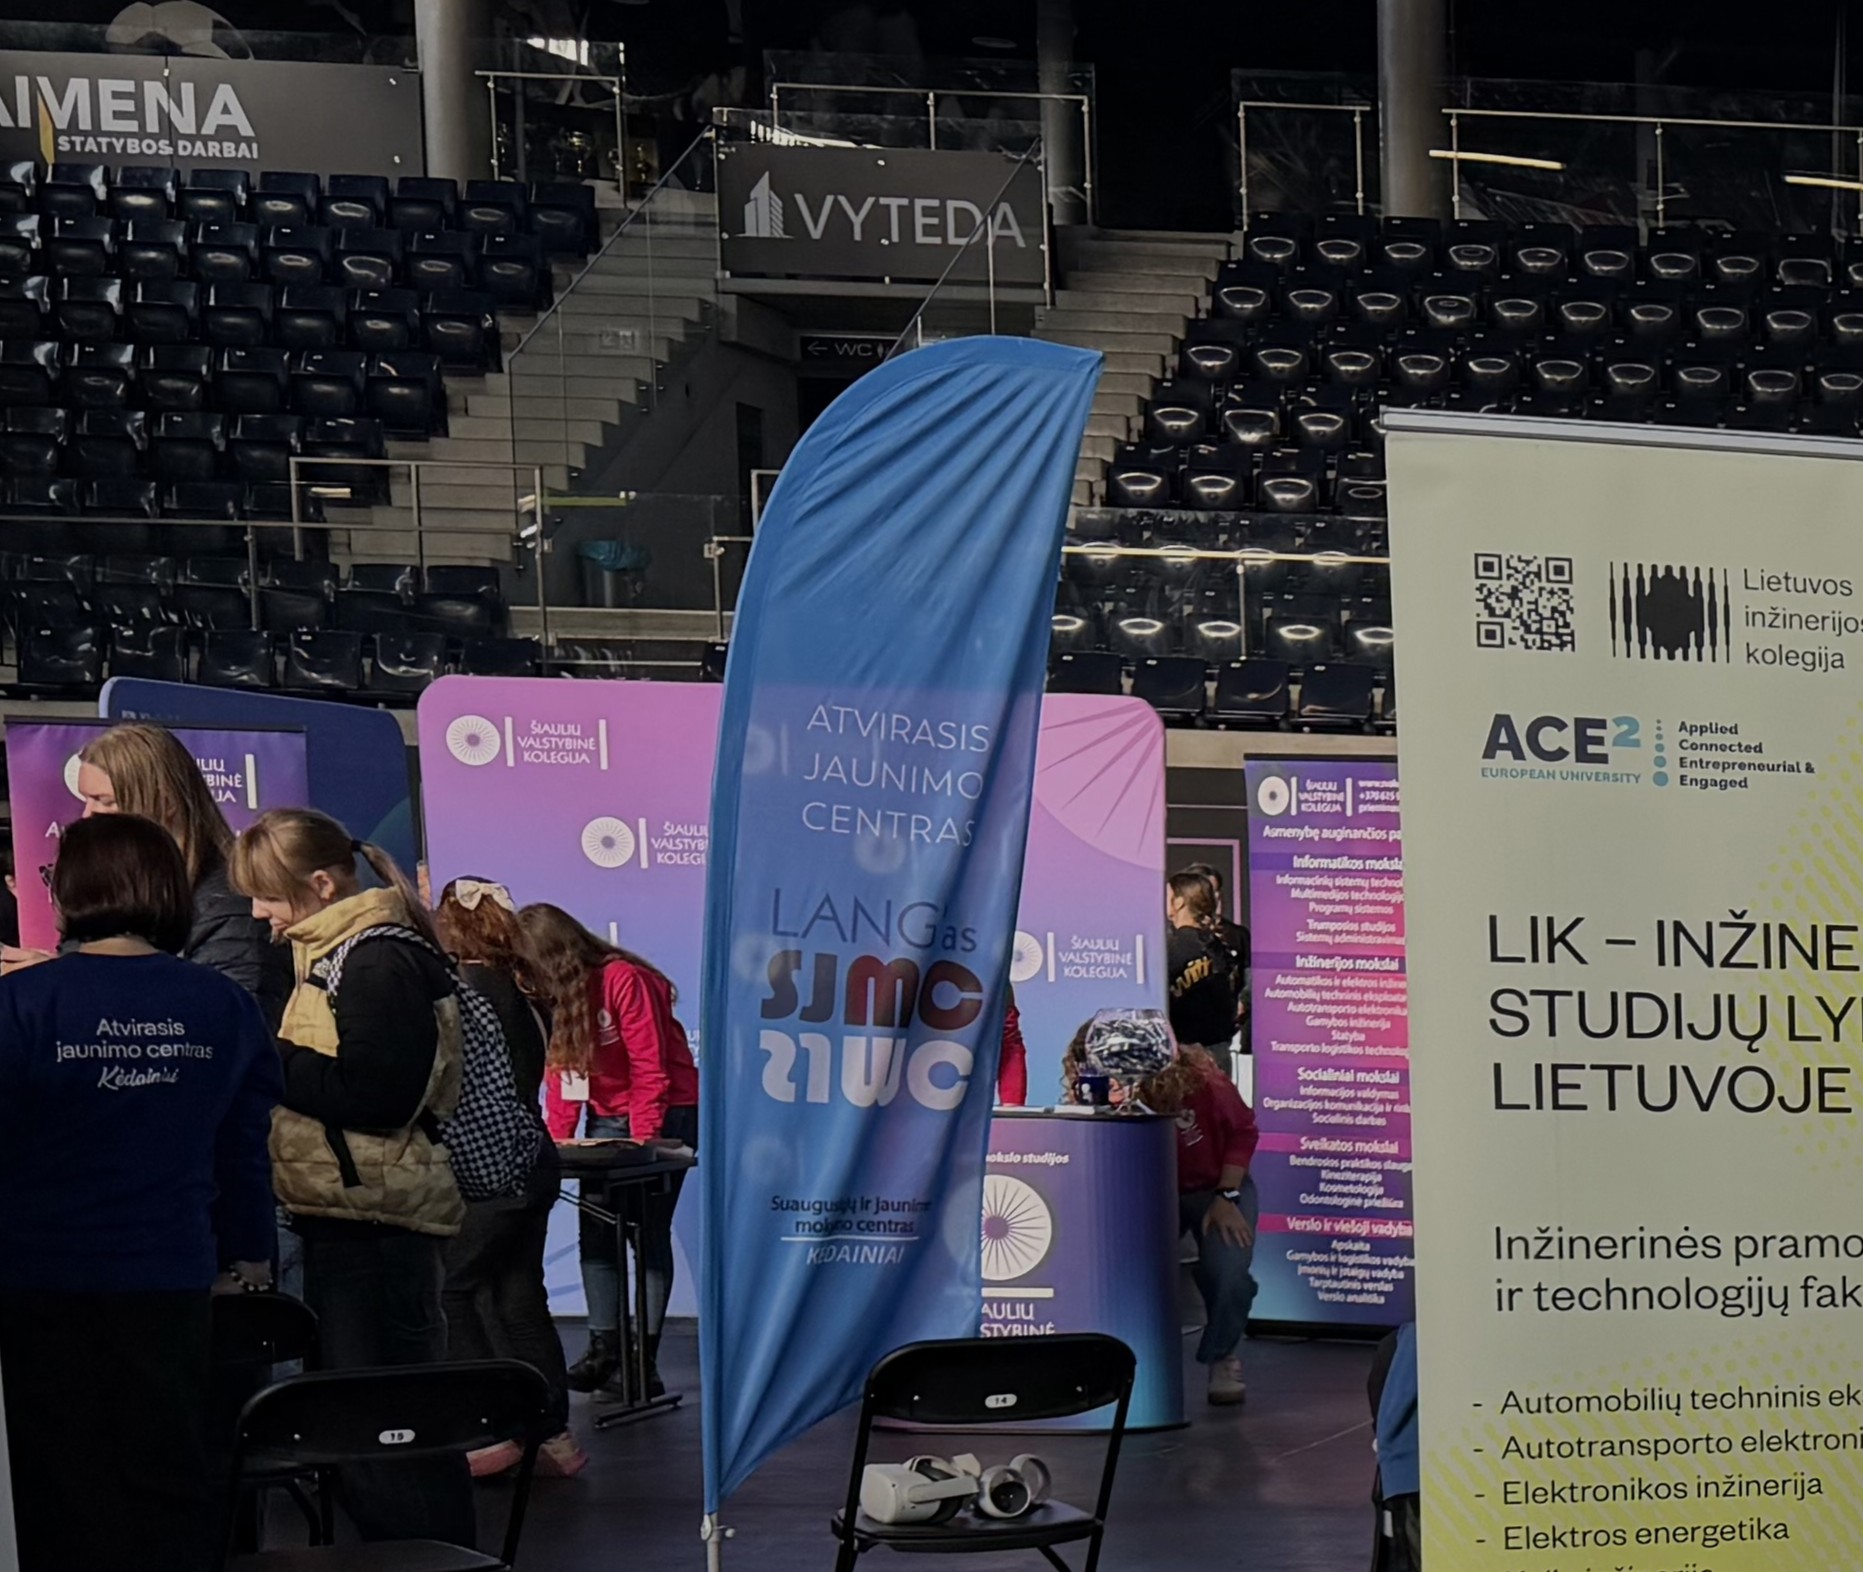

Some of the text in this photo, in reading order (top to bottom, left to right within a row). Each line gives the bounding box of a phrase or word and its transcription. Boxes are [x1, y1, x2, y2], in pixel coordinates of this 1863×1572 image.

[57, 134, 259, 161] STATYBOS DARBAI
[793, 193, 1028, 249] VYTEDA
[833, 341, 874, 358] WC
[1743, 568, 1854, 598] Lietuvos
[1745, 642, 1847, 673] kolegija
[516, 733, 597, 751] VALSTYBINĖ
[806, 703, 990, 753] ATVIRASIS
[1679, 720, 1739, 736] Applied
[522, 748, 592, 765] KOLEGIJA
[1678, 738, 1764, 755] Connected
[803, 752, 984, 800] JAUNIMO
[1480, 766, 1641, 785] EUROPEAN UNIVERSITY
[1679, 756, 1816, 774] Entrepreneurial &
[1679, 773, 1749, 791] Engaged
[801, 801, 976, 847] CENTRAS
[1488, 914, 1590, 965] LIK
[1058, 951, 1133, 965] VALSTYBINĖ
[1063, 964, 1128, 979] KOLEGIJA
[759, 949, 984, 1031] SJMC
[97, 1018, 186, 1037] Atvirasis
[1488, 987, 1768, 1054] STUDIJŲ
[56, 1040, 214, 1063] jaunimo centras
[1493, 1062, 1853, 1114] LIETUVOJE
[1022, 1152, 1070, 1167] studijos
[1494, 1225, 1722, 1262] Inžinerinės
[1496, 1278, 1522, 1311] ir
[1533, 1276, 1789, 1318] technologijų
[1499, 1386, 1682, 1417] Automobilių
[1690, 1386, 1822, 1411] techninis
[1501, 1433, 1733, 1462] Autotransporto
[1502, 1472, 1824, 1506] Elektronikos inžinerija
[1503, 1518, 1790, 1551] Elektros energetika
